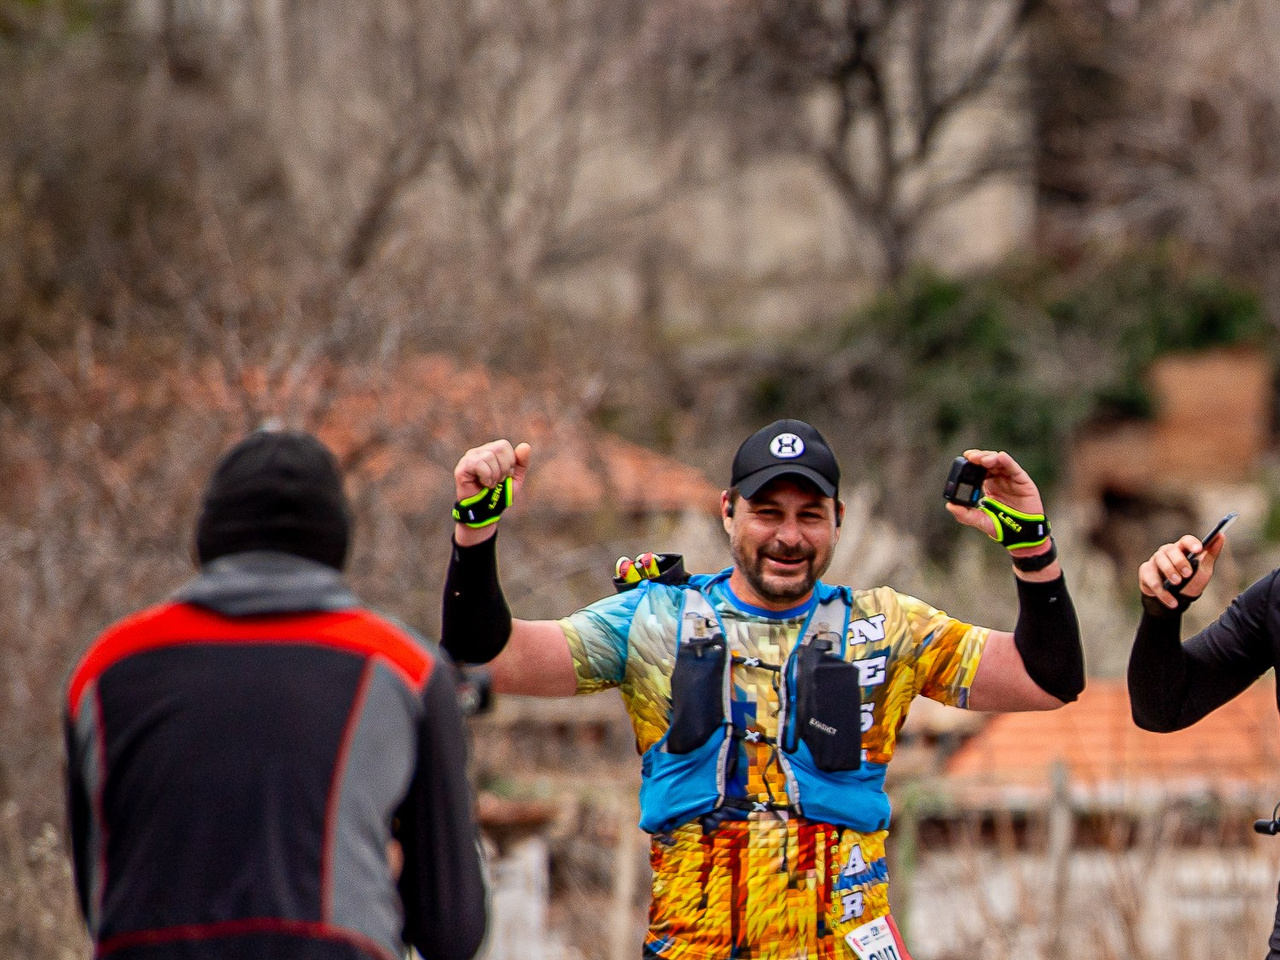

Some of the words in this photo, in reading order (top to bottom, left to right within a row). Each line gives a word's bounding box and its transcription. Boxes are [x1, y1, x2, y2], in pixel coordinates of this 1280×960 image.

[488, 483, 503, 510] LEKI
[998, 512, 1022, 533] LEKI
[830, 831, 839, 929] ARATHON
